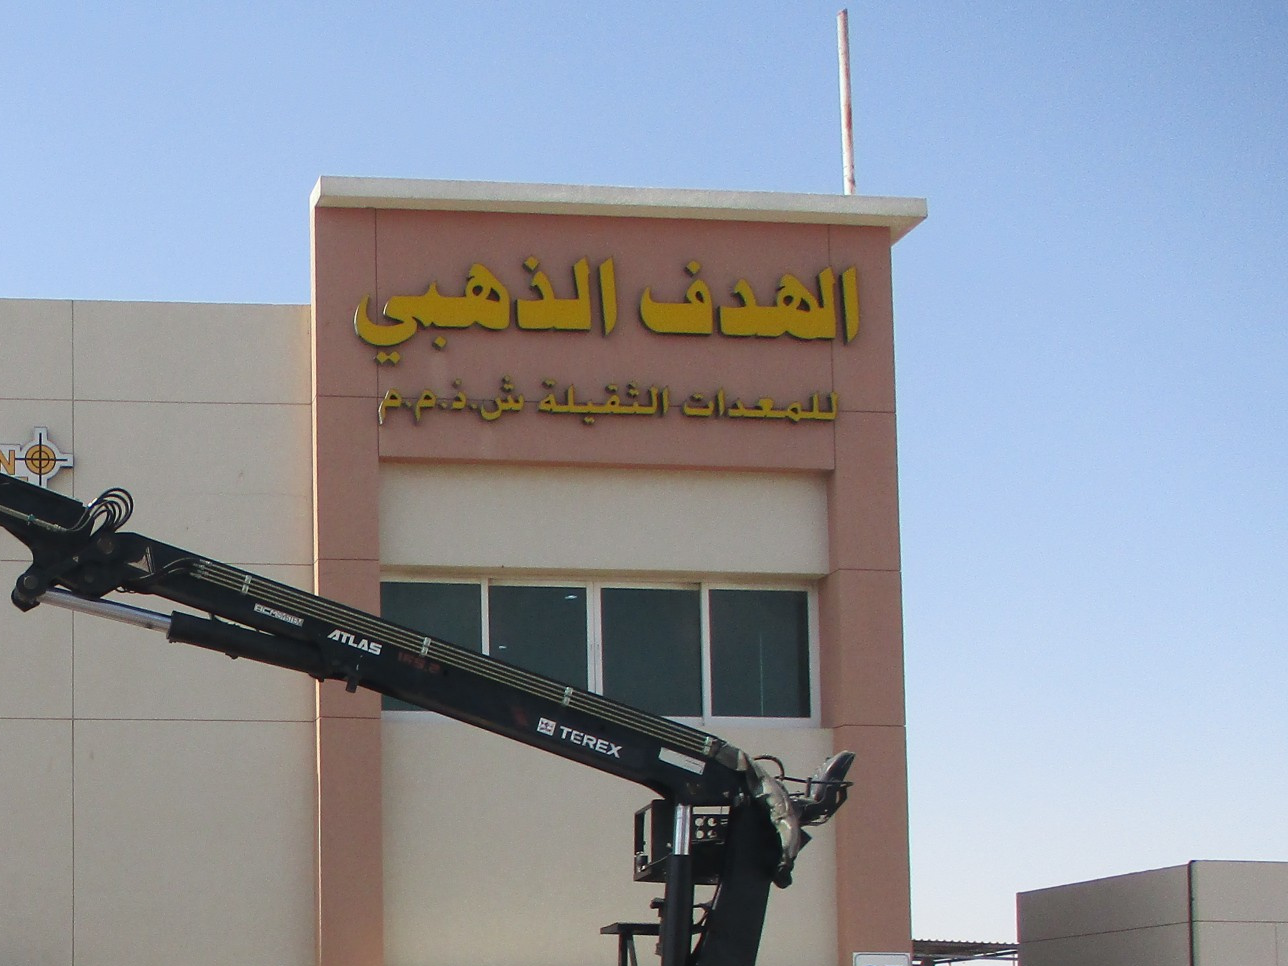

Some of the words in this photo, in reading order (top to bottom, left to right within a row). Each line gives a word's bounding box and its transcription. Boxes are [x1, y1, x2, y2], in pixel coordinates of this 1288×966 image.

[353, 255, 618, 365] الذهبي
[639, 260, 859, 345] الهدف
[537, 379, 670, 426] الثقيلة
[682, 386, 838, 424] للمعدات
[327, 628, 383, 656] ATLAS
[559, 725, 623, 759] TEREX
